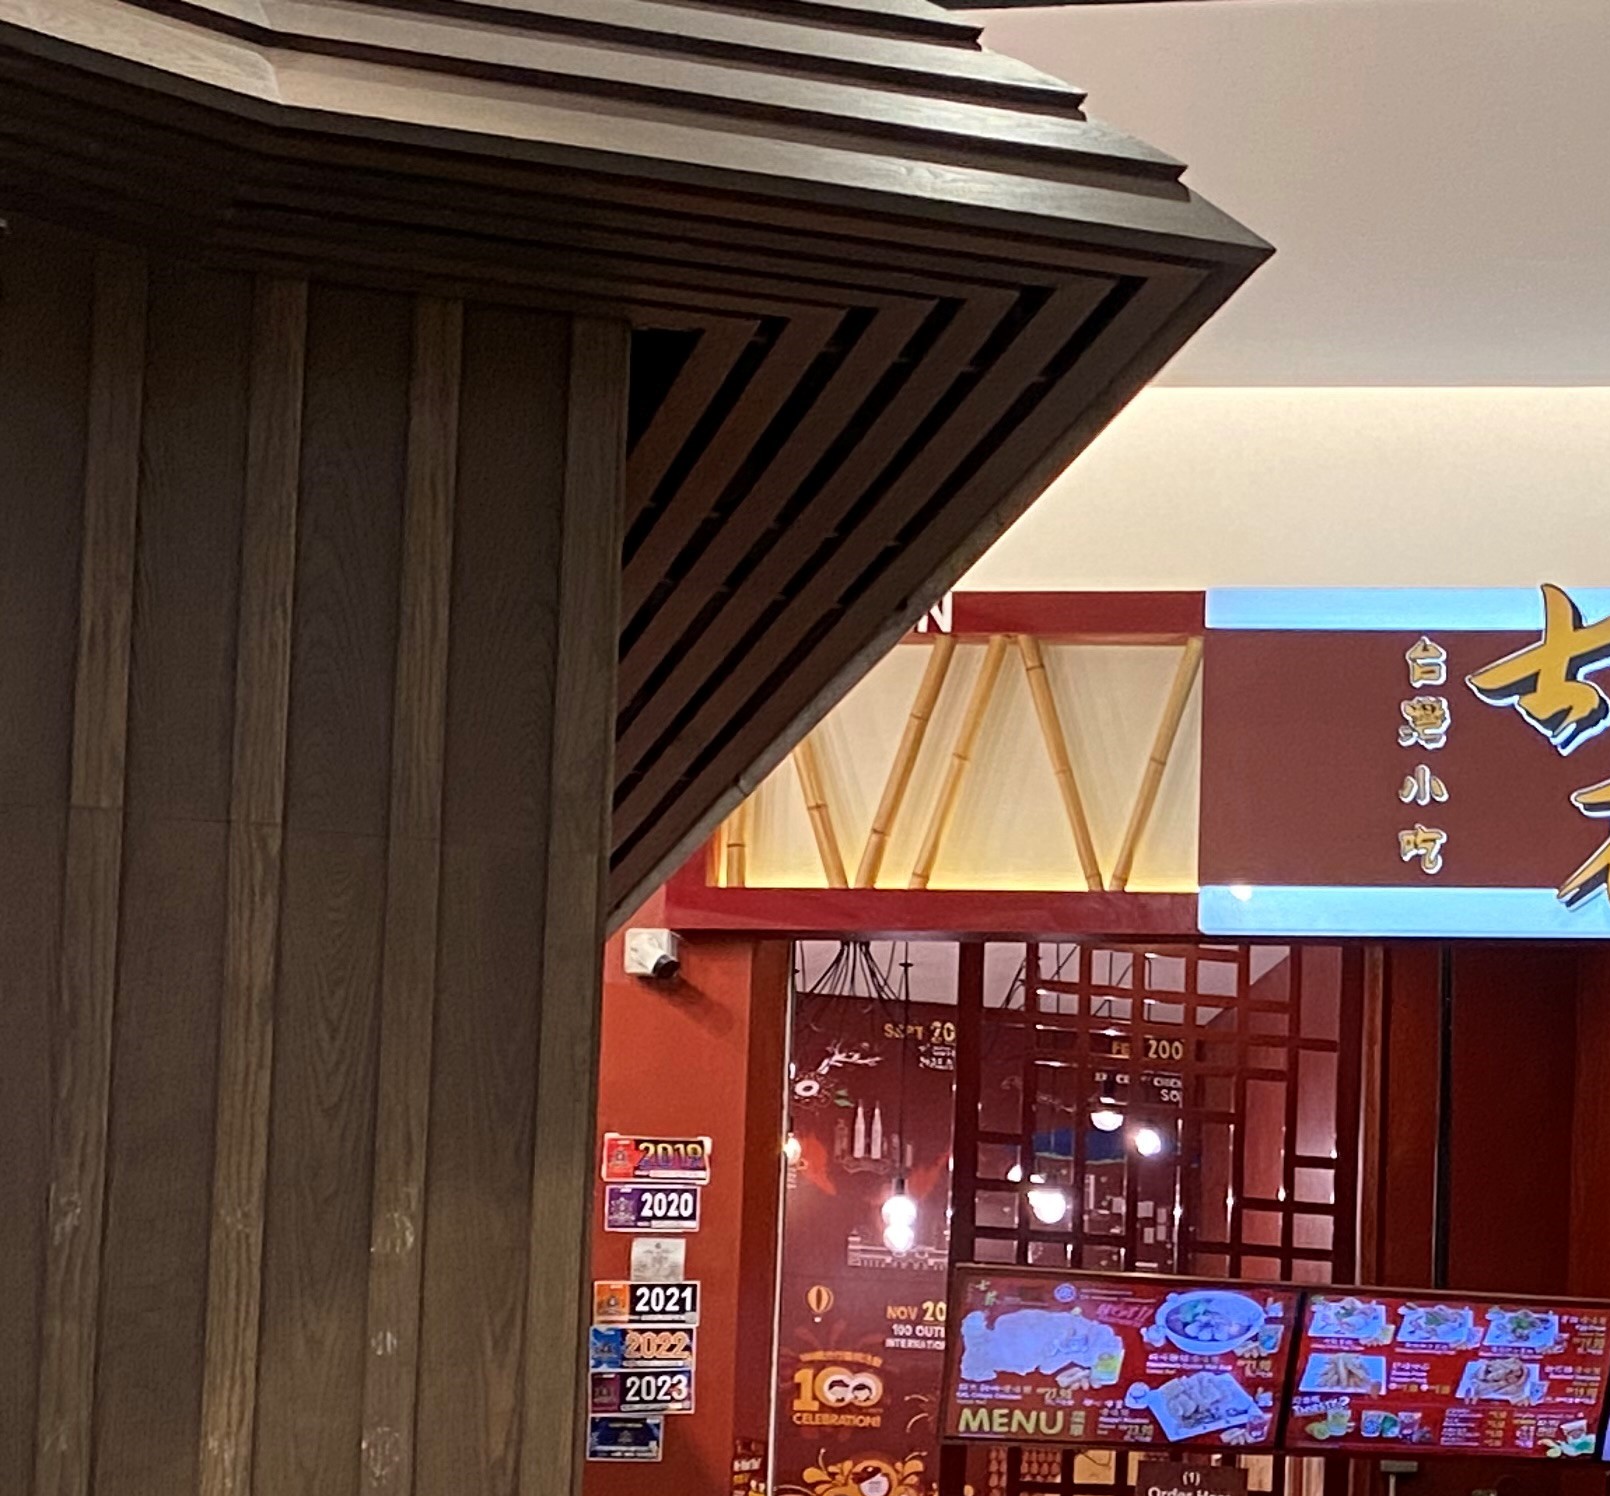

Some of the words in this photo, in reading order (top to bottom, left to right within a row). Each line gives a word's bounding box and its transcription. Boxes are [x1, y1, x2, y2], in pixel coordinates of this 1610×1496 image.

[638, 1142, 704, 1170] 2019
[640, 1192, 694, 1217] 2020
[635, 1286, 693, 1312] 2021
[886, 1305, 918, 1320] NOV
[623, 1330, 690, 1359] 2022
[625, 1375, 689, 1401] 2023
[959, 1407, 1064, 1435] MENU
[1182, 1471, 1201, 1486] (1)
